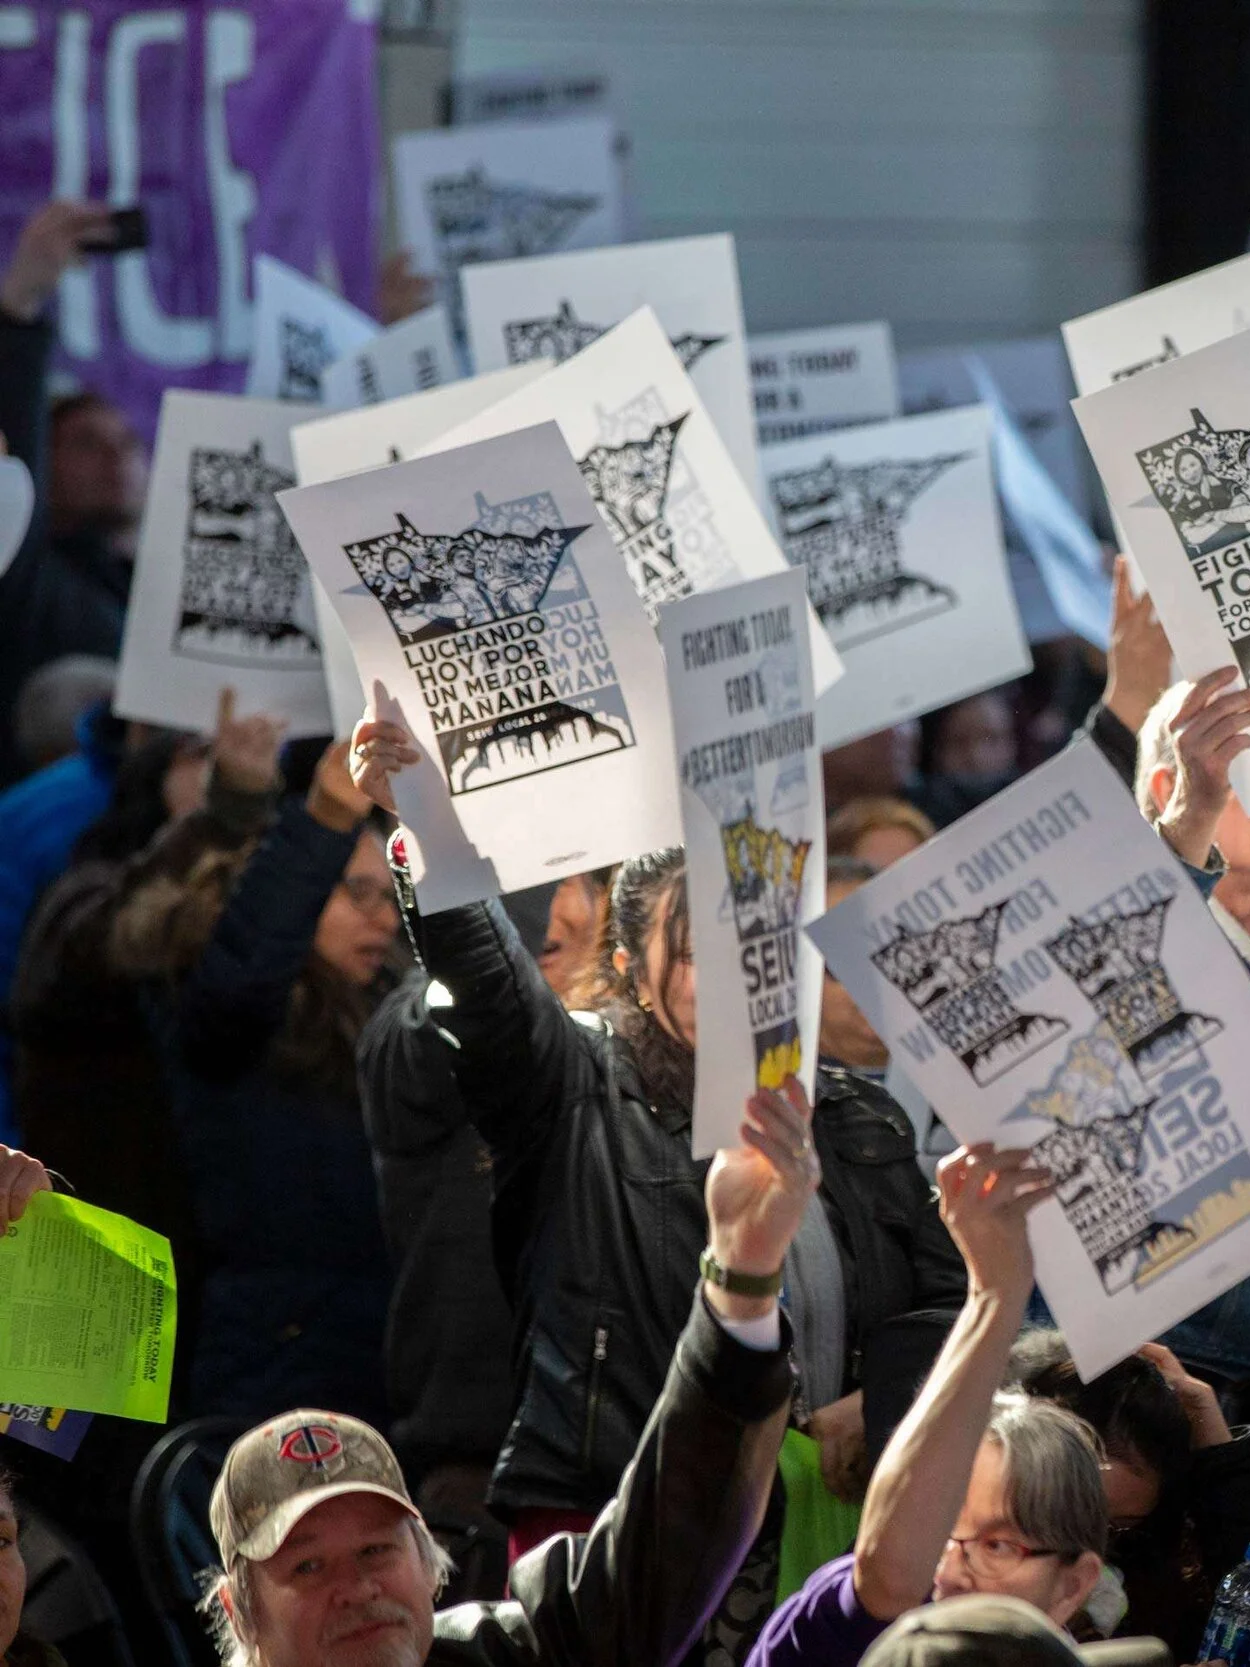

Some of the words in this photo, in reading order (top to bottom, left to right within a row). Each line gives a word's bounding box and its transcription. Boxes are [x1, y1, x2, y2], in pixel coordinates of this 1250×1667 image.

[404, 616, 545, 669] LUCHANDO
[416, 655, 474, 690] HOY
[484, 639, 544, 670] POR
[422, 684, 457, 708] UN
[464, 660, 551, 697] MEJOR
[149, 1341, 160, 1383] TODAY
